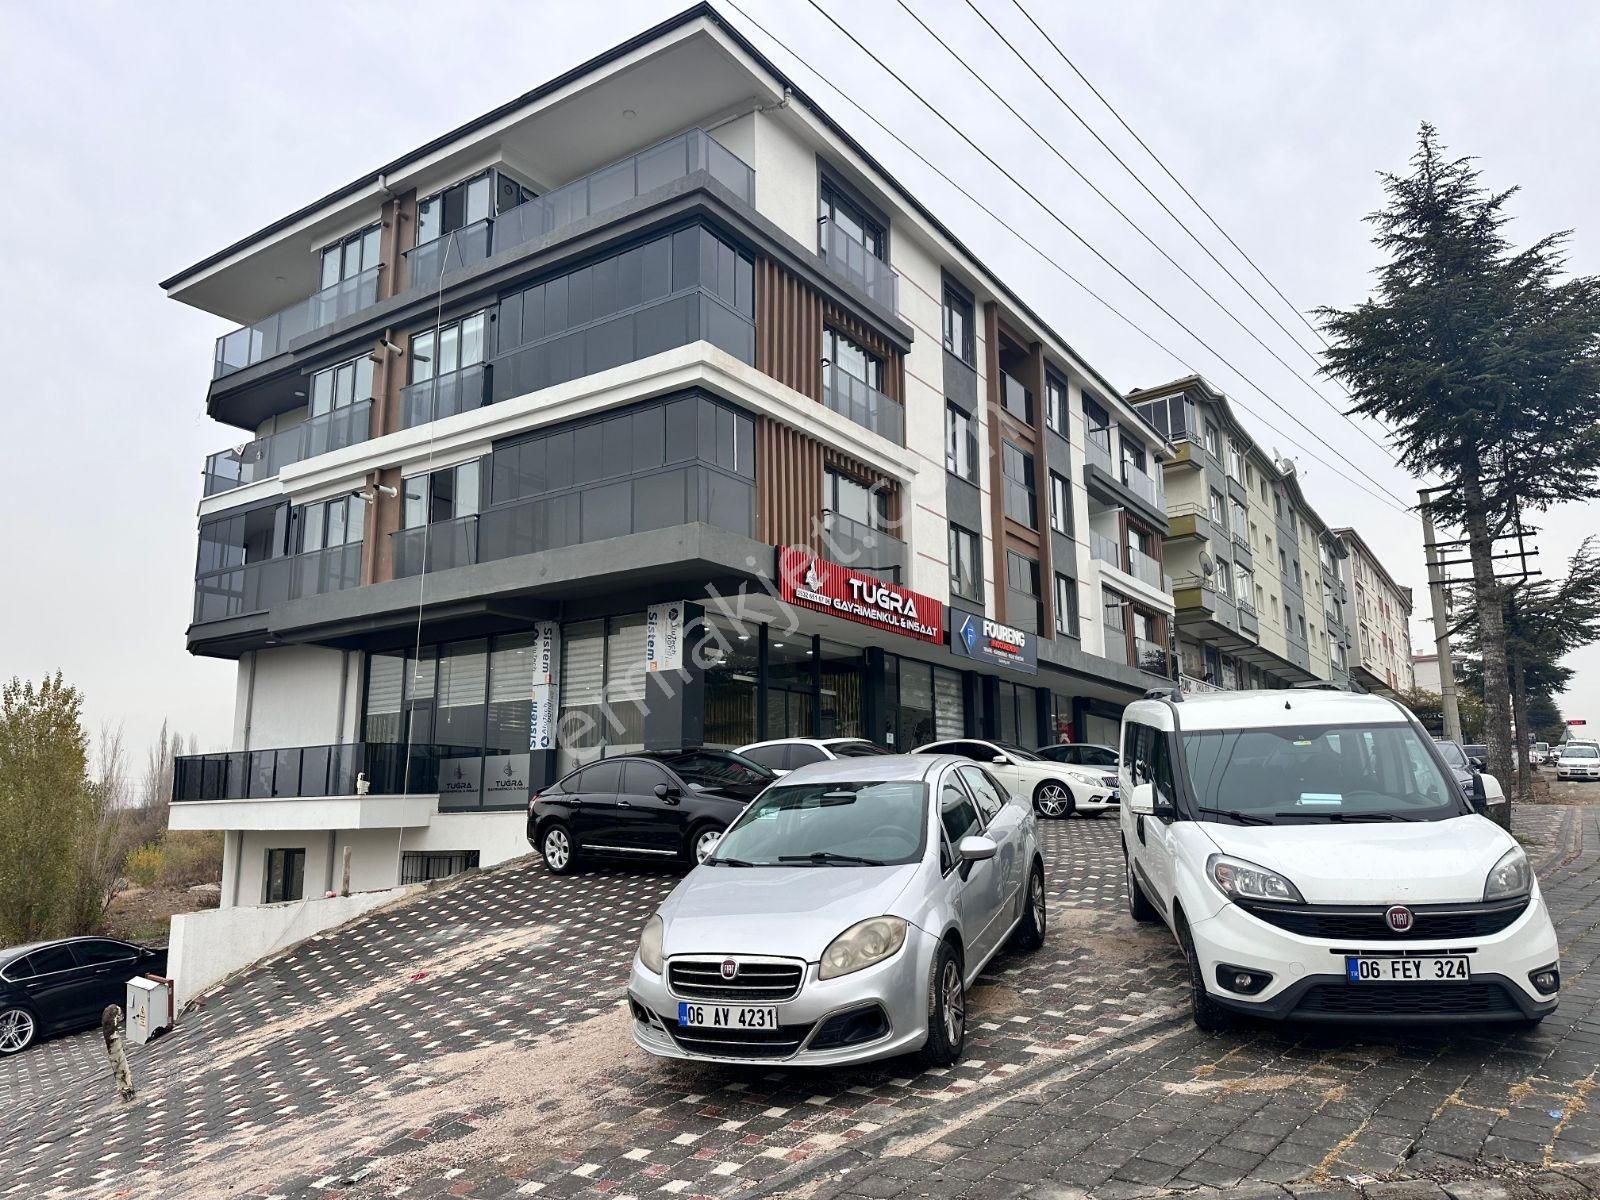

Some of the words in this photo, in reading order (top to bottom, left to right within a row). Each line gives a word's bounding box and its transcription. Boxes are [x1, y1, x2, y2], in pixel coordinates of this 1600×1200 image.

[848, 578, 918, 619] TUĞRA
[900, 618, 907, 628] &
[982, 620, 1026, 647] FOURENG
[647, 611, 657, 661] Sistem
[542, 627, 552, 673] Sistem
[1392, 913, 1407, 926] FIAT
[724, 964, 734, 974] FIAT
[1360, 960, 1380, 978] 06
[1391, 960, 1421, 979] FEY
[1434, 960, 1466, 978] 324
[688, 1006, 703, 1025] 06
[713, 1007, 729, 1026] AV
[738, 1009, 774, 1028] 4231
